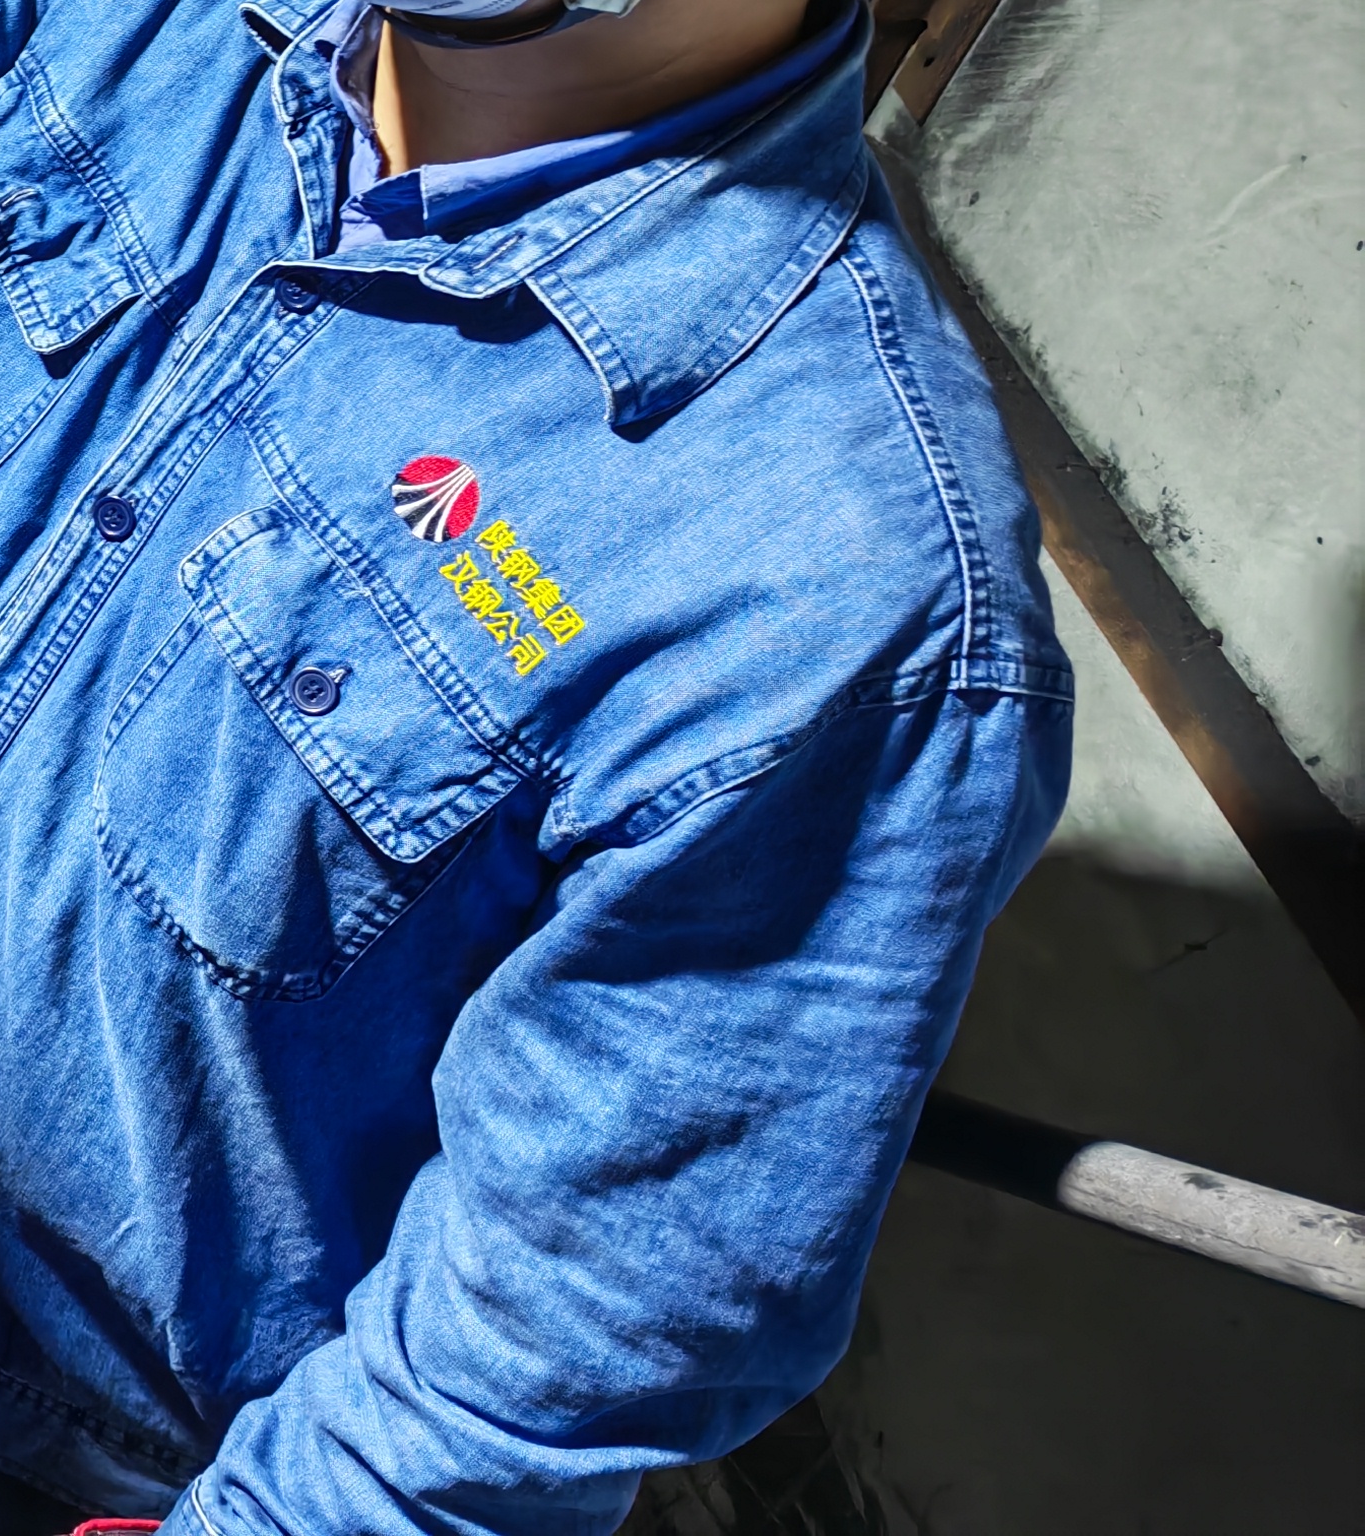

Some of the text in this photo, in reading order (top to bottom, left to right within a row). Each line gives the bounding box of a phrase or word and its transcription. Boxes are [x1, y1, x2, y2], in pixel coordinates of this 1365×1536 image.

[440, 551, 546, 675] 汉钢公司
[475, 520, 585, 645] 陕钢集团
